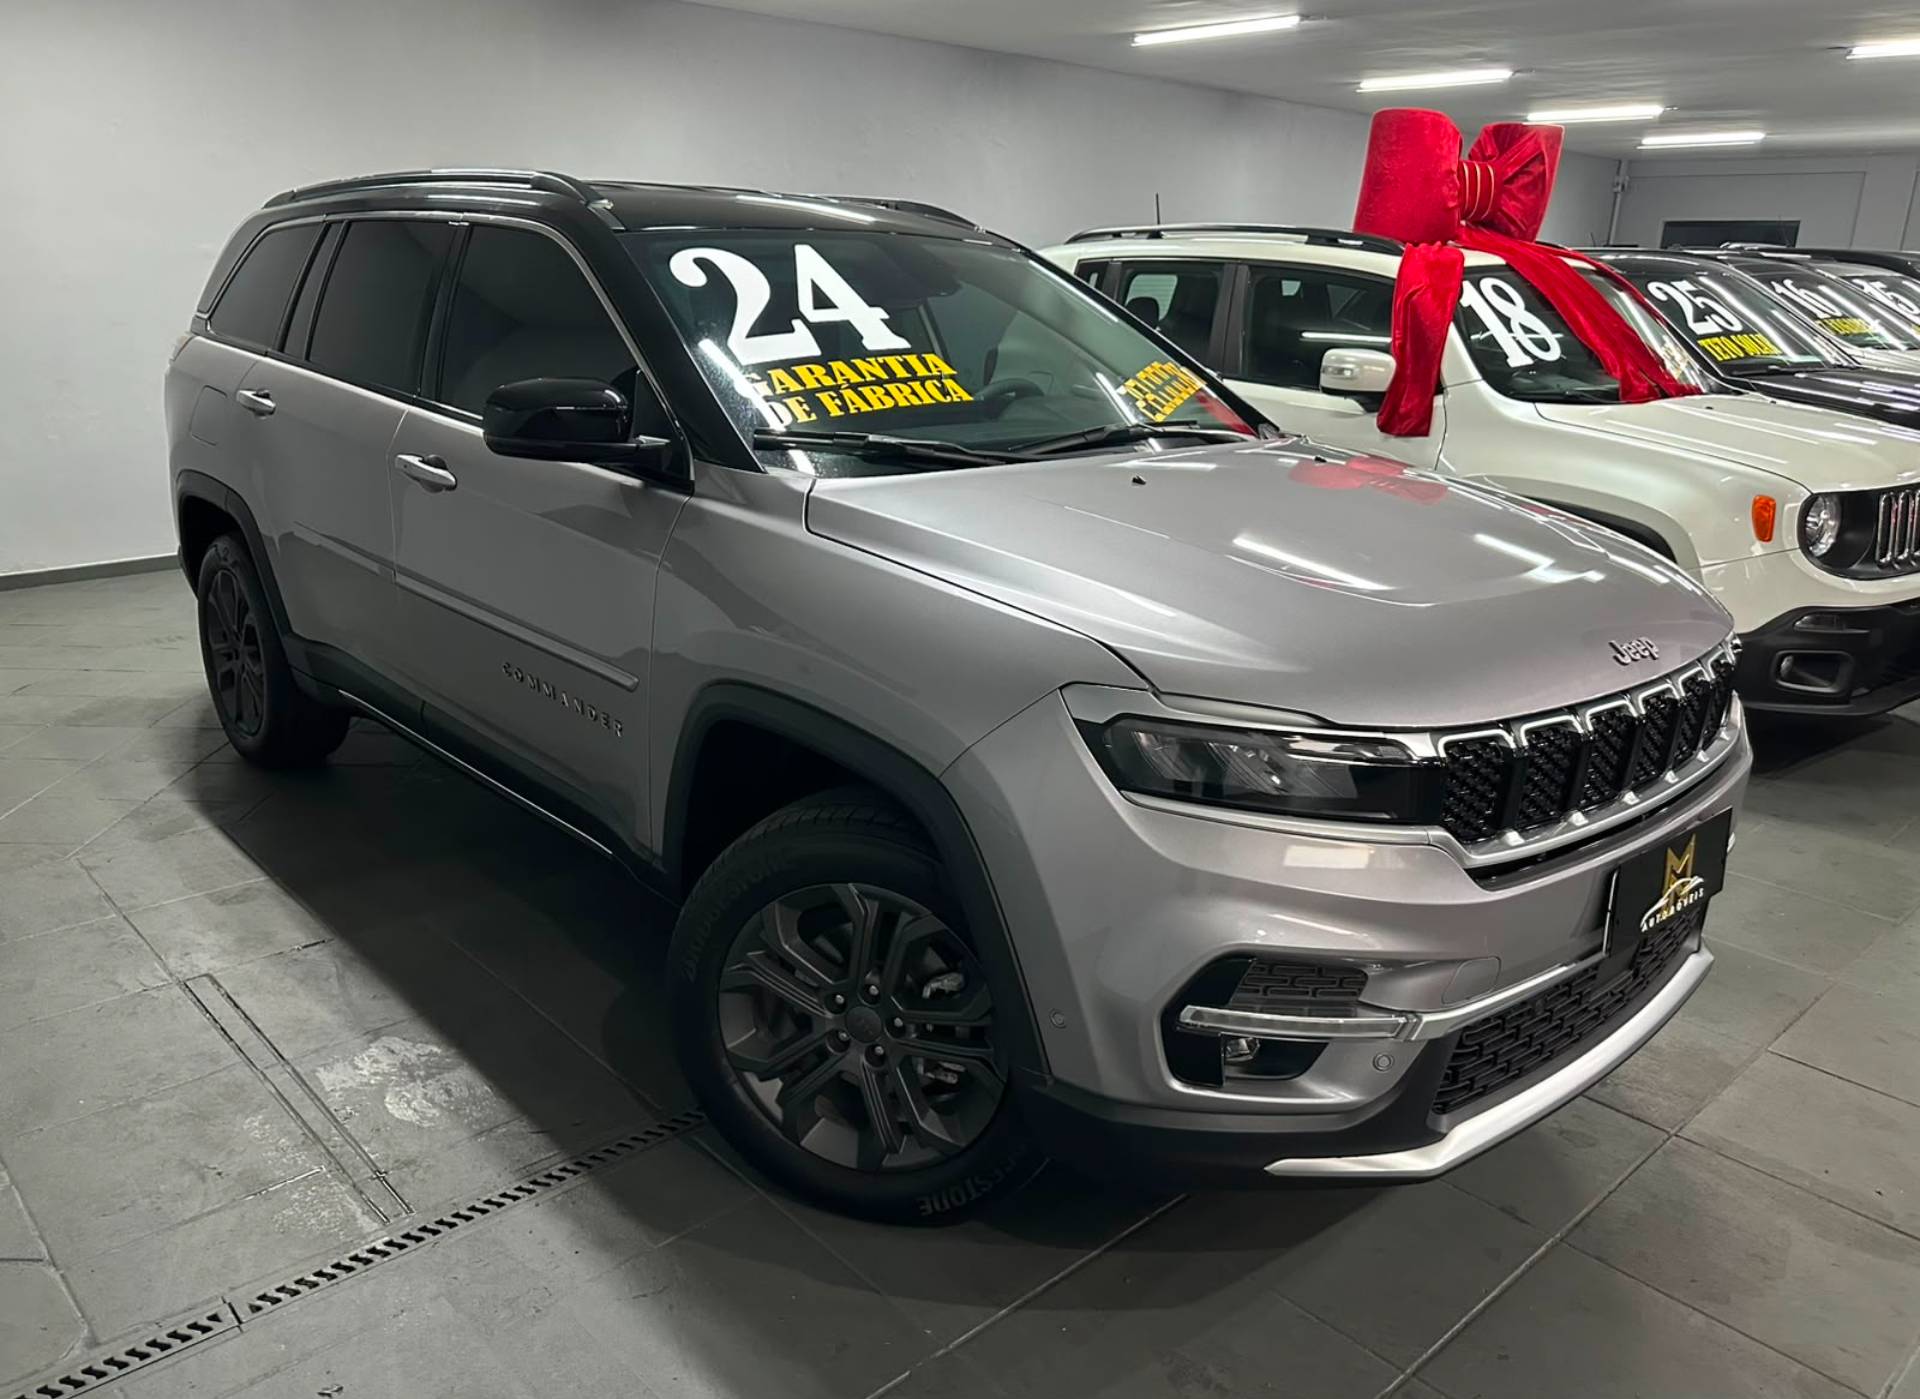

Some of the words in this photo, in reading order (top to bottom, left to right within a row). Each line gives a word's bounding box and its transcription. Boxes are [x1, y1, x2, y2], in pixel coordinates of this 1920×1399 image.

[669, 244, 911, 365] 24
[1647, 280, 1743, 335] 25
[1770, 279, 1843, 319] 16
[1459, 278, 1561, 368] 18
[1697, 336, 1746, 361] TETO
[744, 353, 959, 398] GARANTIA
[816, 378, 974, 417] FÁBRICA
[1609, 636, 1659, 666] Jeep
[502, 662, 624, 738] COMMANDER
